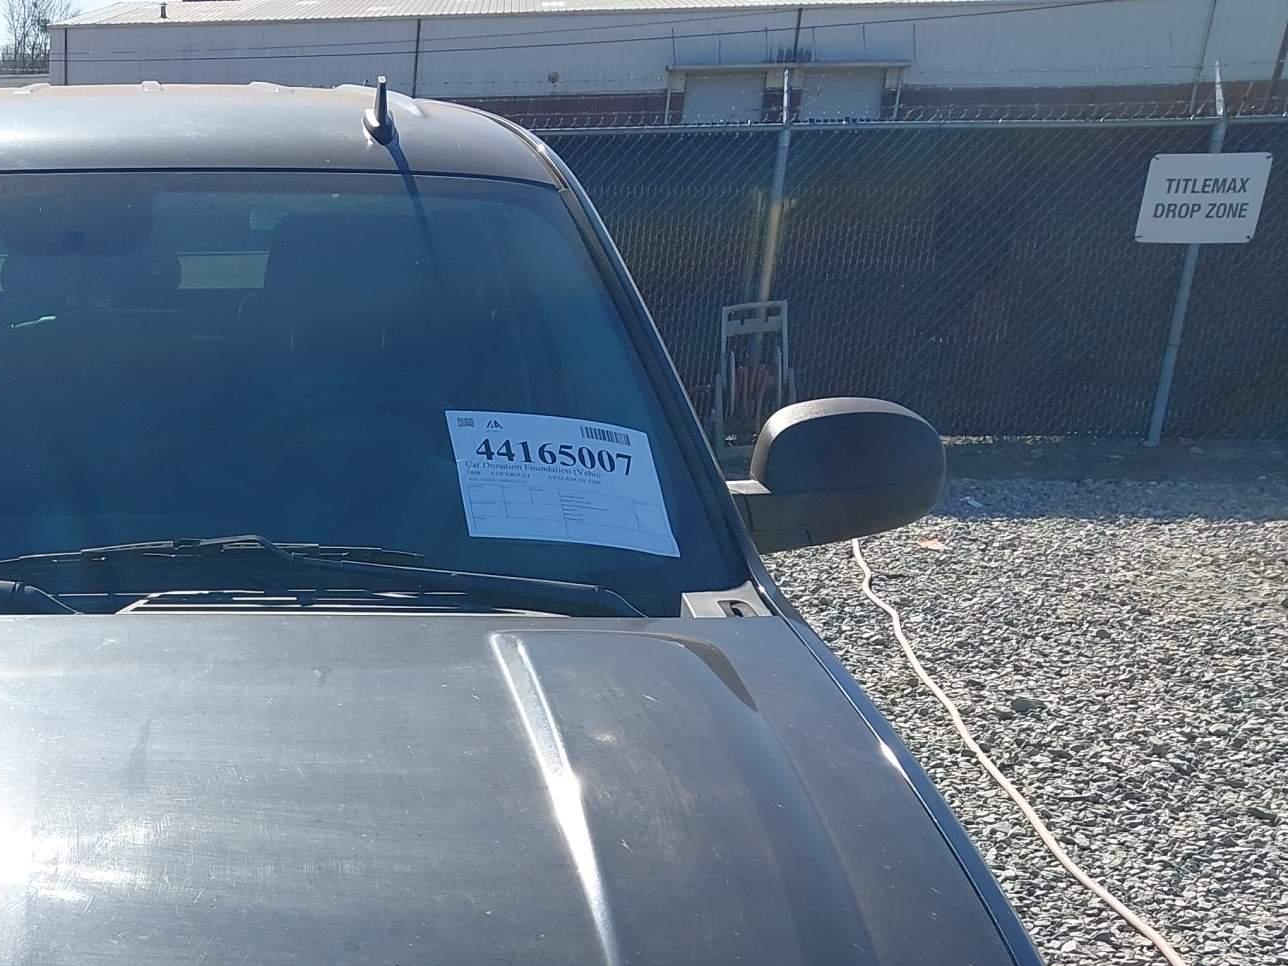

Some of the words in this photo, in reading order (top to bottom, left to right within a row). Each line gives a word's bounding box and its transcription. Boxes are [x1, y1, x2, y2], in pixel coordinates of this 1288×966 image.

[1165, 177, 1250, 194] TITLEMAX
[1153, 203, 1201, 219] DROP
[1205, 202, 1250, 219] ZONE
[475, 438, 632, 476] 44165007
[465, 460, 481, 468] Car
[483, 462, 522, 471] Donation
[524, 463, 571, 474] Foundation
